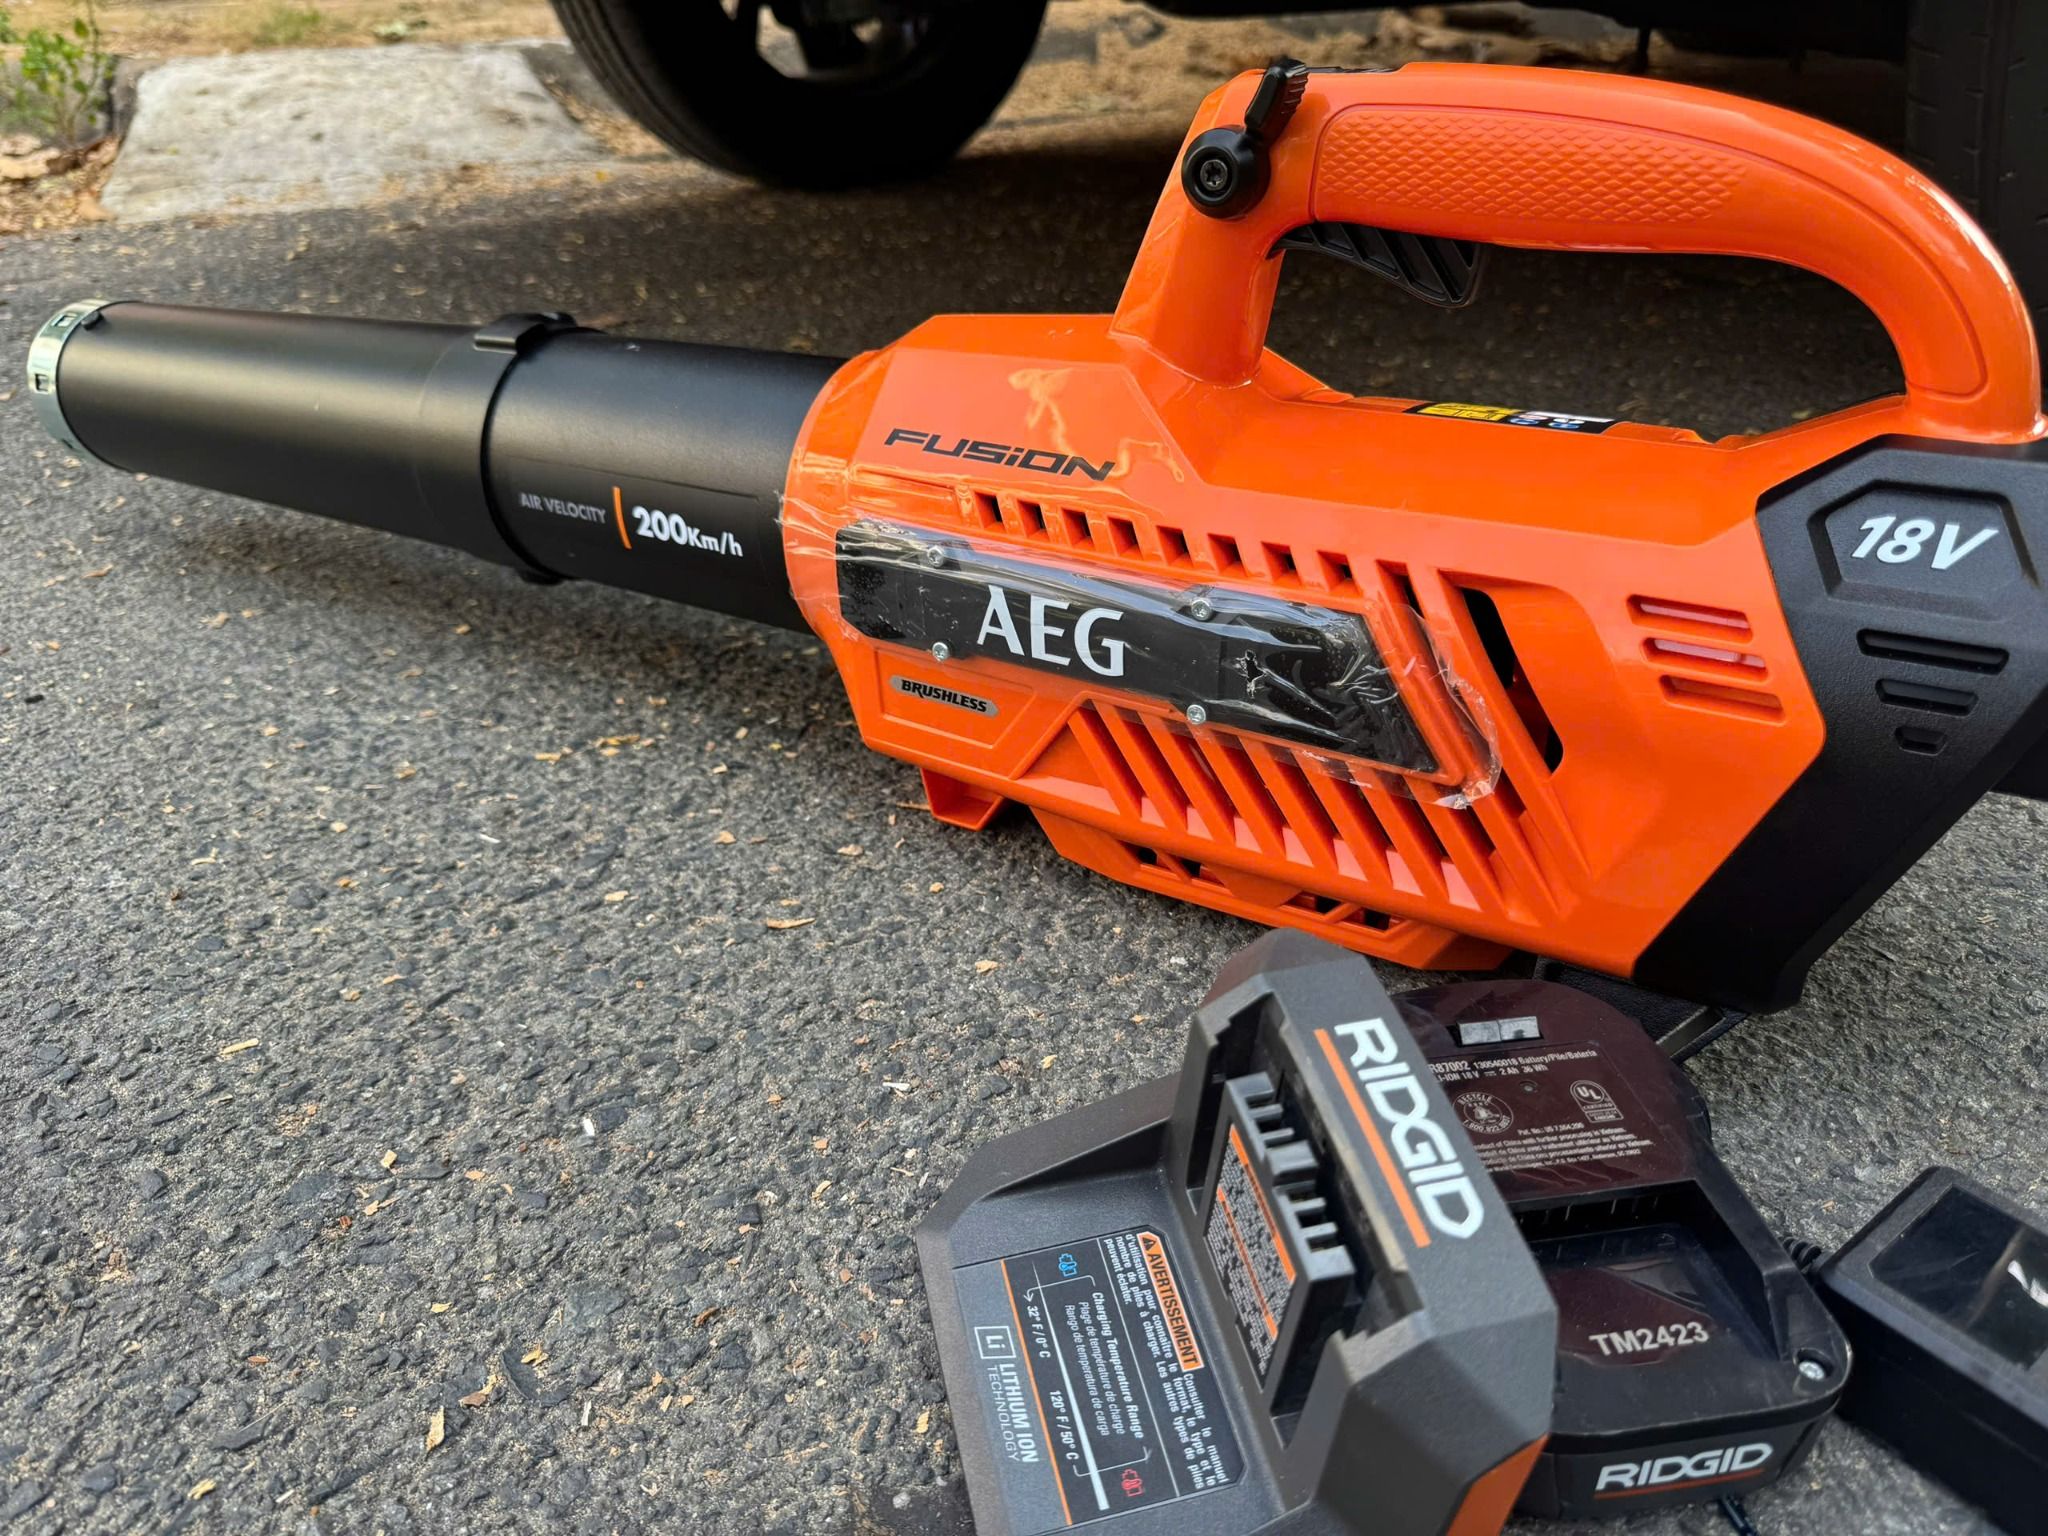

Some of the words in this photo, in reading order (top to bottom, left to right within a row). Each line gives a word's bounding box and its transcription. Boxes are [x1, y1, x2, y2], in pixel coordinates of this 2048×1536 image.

[519, 492, 544, 512] AIR
[543, 498, 606, 524] VELOCITY
[1852, 516, 1999, 570] 18V
[977, 584, 1124, 677] AEG
[901, 680, 987, 712] BRUSHLESS
[1577, 1086, 1601, 1100] UL
[1334, 1018, 1485, 1239] RIDGID
[1115, 1236, 1132, 1268] nombre
[1125, 1233, 1149, 1286] d'utilisation
[1104, 1238, 1124, 1273] peuvent
[1116, 1273, 1132, 1305] éclater.
[1127, 1271, 1137, 1283] de
[1130, 1286, 1145, 1308] piles
[1141, 1289, 1158, 1310] pour
[1147, 1253, 1199, 1364] AVERTISSEMENT
[1064, 1304, 1079, 1331] Rango
[1078, 1301, 1093, 1325] Plage
[986, 1336, 1006, 1349] Li
[1072, 1332, 1084, 1344] de
[1085, 1325, 1098, 1337] de
[1142, 1320, 1161, 1358] charger.
[1589, 1321, 1709, 1356] TM2423
[1075, 1344, 1099, 1396] temperatura
[1089, 1337, 1112, 1389] température
[1092, 1292, 1113, 1336] Charging
[1106, 1337, 1133, 1402] Temperature
[1126, 1404, 1144, 1439] Range
[1156, 1360, 1168, 1379] Les
[1168, 1362, 1178, 1373] le
[1091, 1397, 1104, 1409] de
[1105, 1390, 1117, 1402] de
[1162, 1381, 1180, 1413] autres
[1173, 1377, 1192, 1413] format,
[1183, 1373, 1206, 1419] Consulter
[987, 1365, 1020, 1462] TECHNOLOGY
[1000, 1363, 1031, 1429] LITHIUM
[1016, 1433, 1040, 1463] ION
[1095, 1410, 1110, 1436] carga
[1108, 1403, 1126, 1435] charge
[1185, 1417, 1197, 1428] le
[1172, 1415, 1189, 1444] types
[1190, 1432, 1206, 1455] type
[1201, 1426, 1212, 1438] le
[1183, 1447, 1195, 1460] de
[1200, 1460, 1212, 1471] et
[1206, 1444, 1230, 1483] manuel
[1595, 1443, 1774, 1490] RIDGID
[1187, 1464, 1205, 1489] piles
[1205, 1475, 1217, 1486] le
